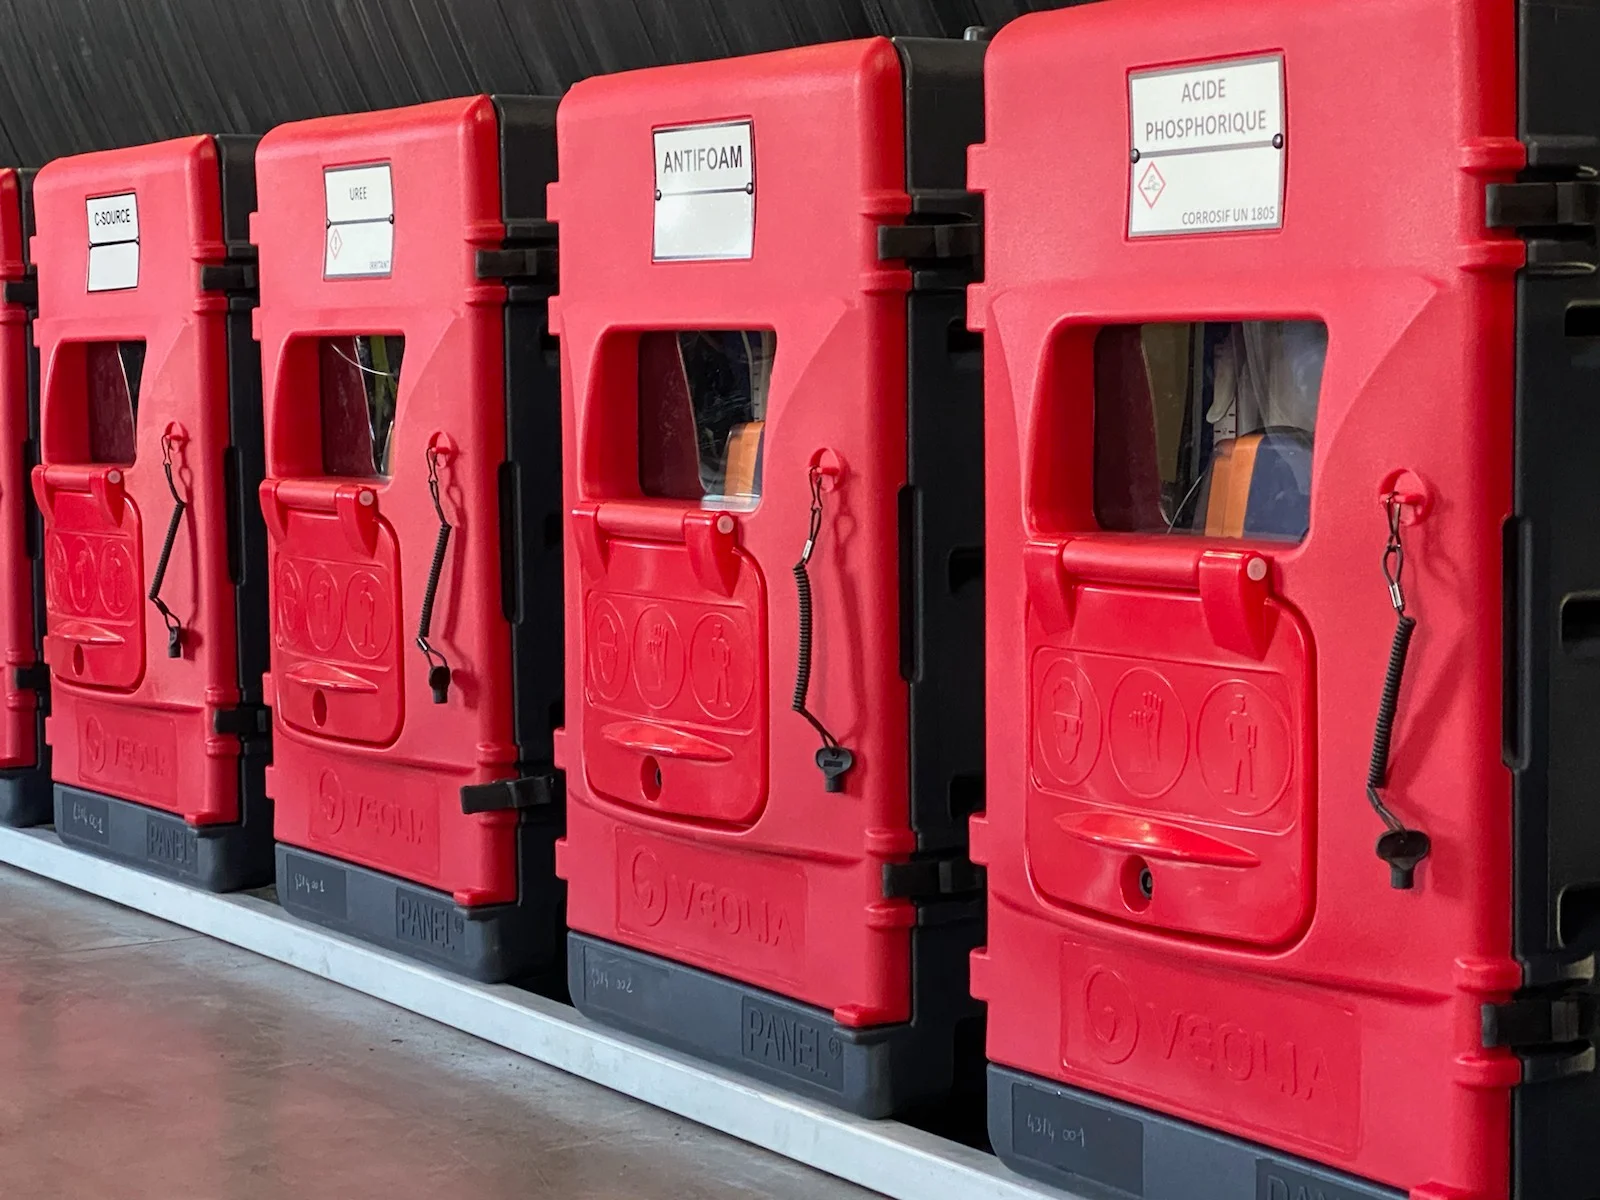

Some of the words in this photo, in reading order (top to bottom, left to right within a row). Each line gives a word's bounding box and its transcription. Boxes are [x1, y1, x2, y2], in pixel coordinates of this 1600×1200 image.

[1181, 78, 1227, 103] ACIDE
[1145, 109, 1267, 142] PHOSPHORIQUE
[663, 144, 743, 174] ANTIFOAM
[349, 186, 368, 201] UREE
[94, 208, 131, 226] C-SOURCE
[1181, 209, 1231, 226] CORROSIF
[1232, 207, 1249, 223] UN
[1251, 205, 1276, 221] 1805
[670, 873, 796, 950] VEOLIA
[1146, 1001, 1339, 1112] VEOLIA
[1027, 1112, 1055, 1145] 4314
[1062, 1126, 1086, 1149] 001
